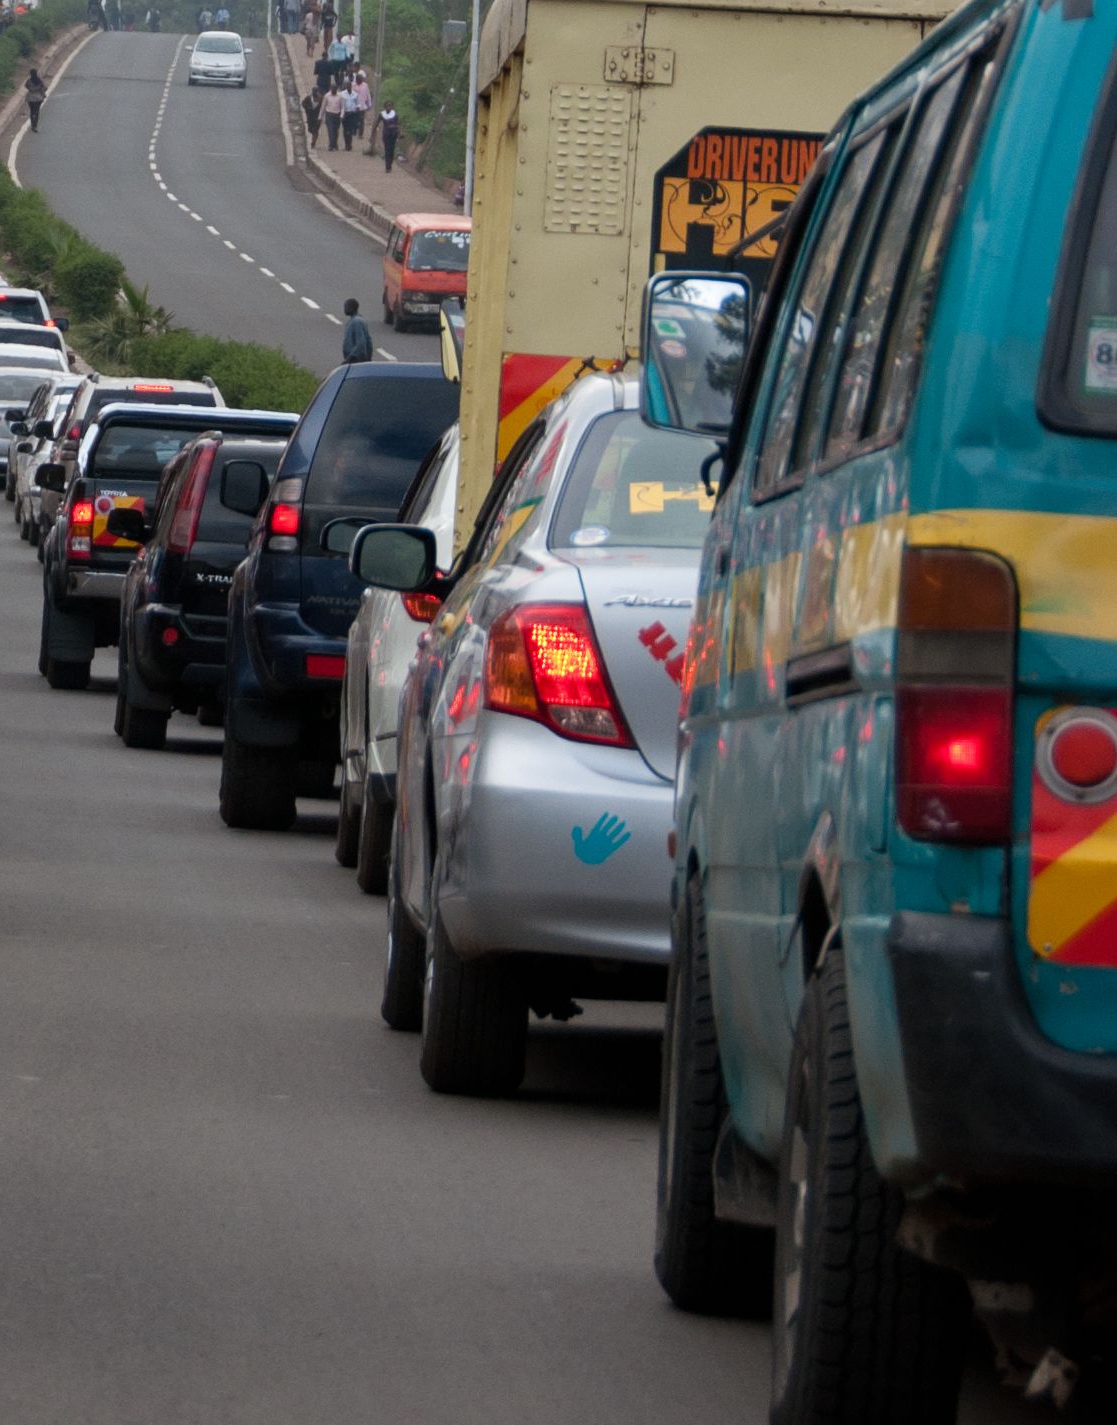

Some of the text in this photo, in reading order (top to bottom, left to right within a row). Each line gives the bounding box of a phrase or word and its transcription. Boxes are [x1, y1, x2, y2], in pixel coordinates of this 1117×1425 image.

[687, 133, 823, 185] DRIVER UN
[100, 489, 128, 497] TOYOTA
[196, 572, 234, 585] X-TRAI
